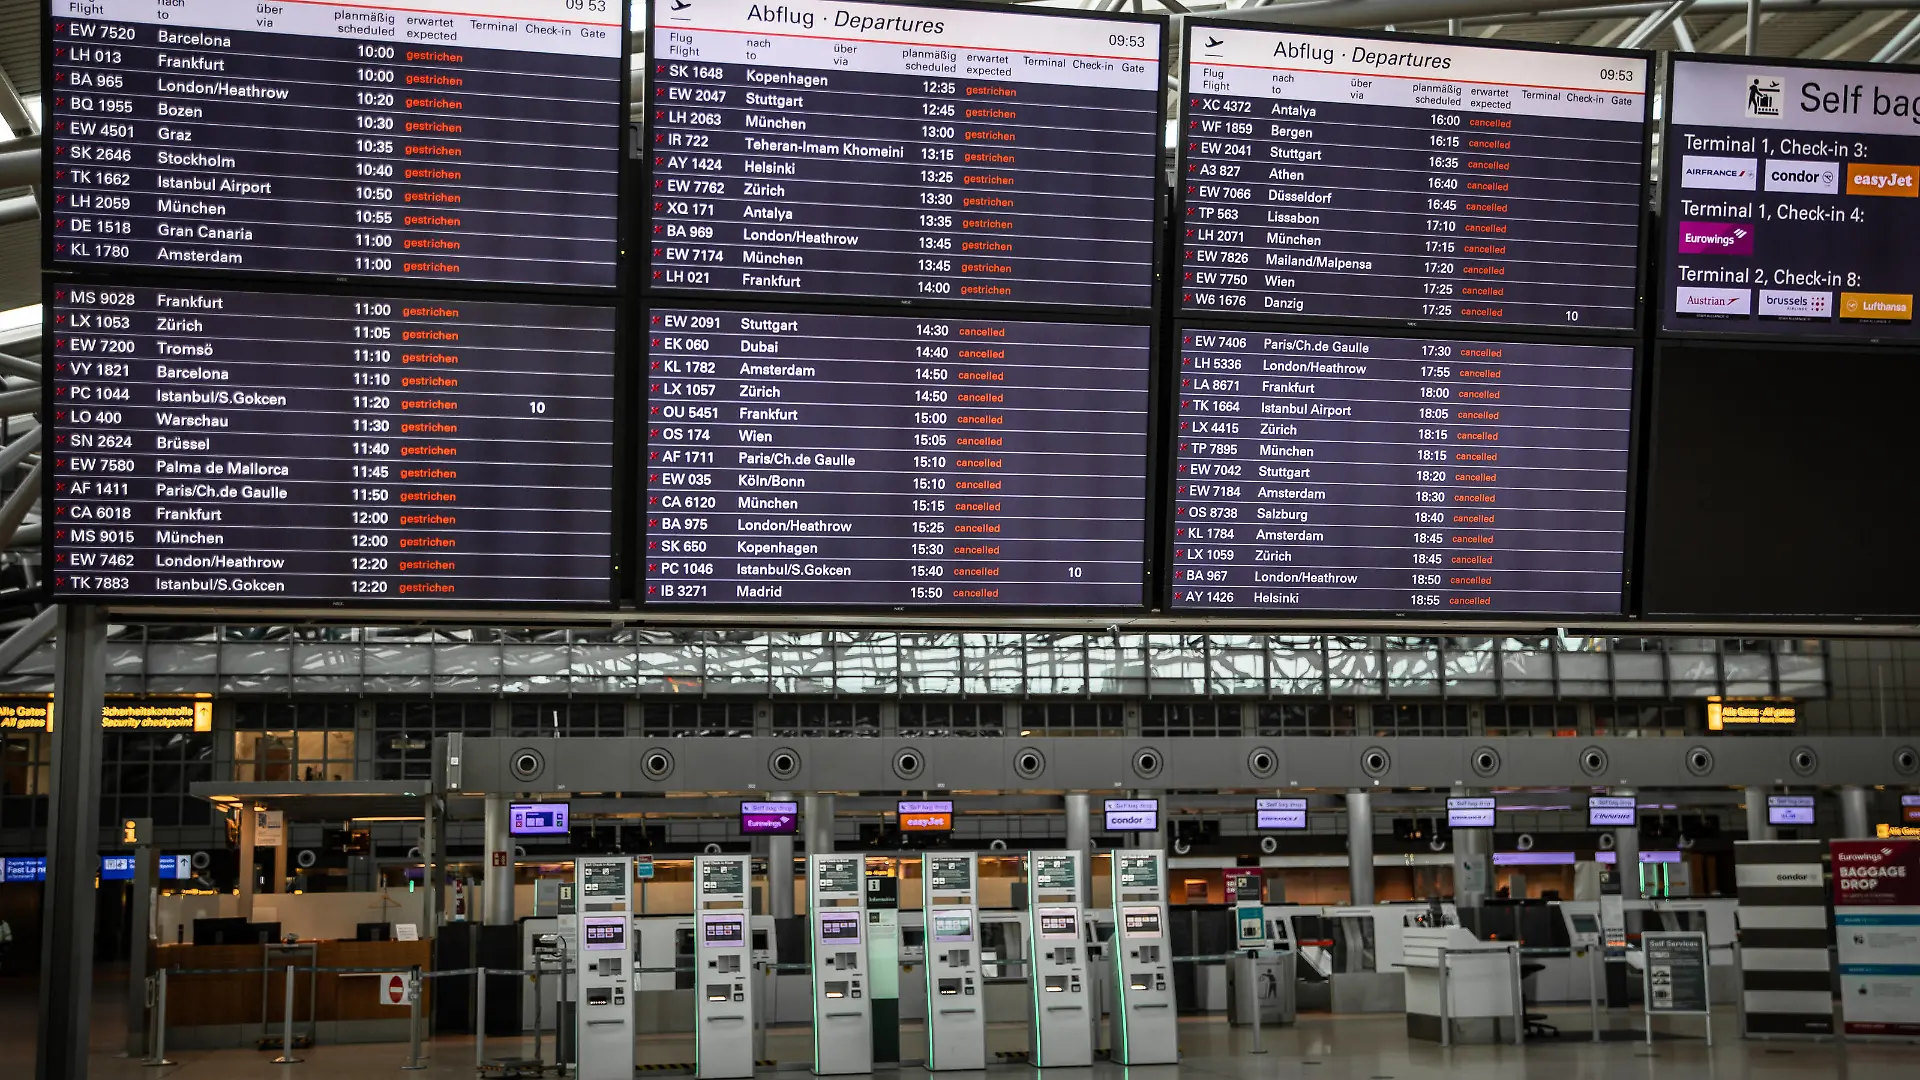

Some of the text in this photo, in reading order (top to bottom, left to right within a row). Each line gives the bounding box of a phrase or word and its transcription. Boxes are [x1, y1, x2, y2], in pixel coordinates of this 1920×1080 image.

[69, 2, 105, 16] Flight
[747, 4, 945, 34] Abflug Departures
[70, 23, 463, 63] EW 7520 Barcelona 10:00 gestrichen
[670, 32, 693, 45] Flug
[747, 39, 771, 48] nach
[1108, 34, 1145, 48] 09:53
[670, 45, 700, 58] Flight
[746, 51, 757, 60] to
[833, 43, 857, 54] über
[902, 48, 957, 63] planmäßig
[1273, 41, 1452, 69] Abflug Departures
[833, 56, 849, 66] via
[966, 54, 1009, 64] erwartet
[1023, 56, 1145, 73] Terminal Check-in Gate
[905, 61, 957, 73] scheduled
[966, 67, 1012, 77] expected
[669, 64, 1017, 97] SK 1648 Kopenhagen 12:35 gestrichen
[1600, 68, 1633, 82] 09:53
[71, 72, 463, 110] BA 965 London/Heathrow 10:20 gestrichen
[1800, 82, 1863, 114] Self
[668, 133, 1015, 163] IR 722 Teheran-Imam Khomeini 13:15 gestrichen
[1684, 133, 1868, 158] Terminal 1, Check-in 3:
[1199, 163, 1509, 192] A3 827 Athen 16:40 cancelled
[1771, 170, 1820, 183] condor
[1853, 173, 1913, 189] easyJet
[70, 170, 461, 203] TK 1662 Istanbul Airport 10:50 gestrichen
[1680, 199, 1864, 223] Terminal 1, Check-in 4:
[1685, 233, 1735, 247] Eurowings
[1197, 250, 1505, 275] EW 7826 Mailand/Malpensa 17:20 cancelled
[1678, 265, 1861, 287] Terminal 2, Check-in 8:
[1195, 293, 1578, 322] W6 1676 Danzig 17:25 cancelled 10
[1686, 295, 1726, 306] Austrian
[1766, 295, 1808, 306] brussels
[1863, 301, 1907, 312] Lufthansa
[664, 315, 1005, 337] EW 2091 Stuttgart 14:30 cancelled
[1194, 357, 1501, 379] LH 5336 London/Heathrow 17:55 cancelled
[71, 386, 546, 414] PC 1044 Istanbul/S.Gokcen 11:20 gestrichen 10
[71, 434, 457, 456] SN 2624 Brüssel 11:40 gestrichen
[1188, 506, 1495, 523] OS 8738 Salzburg 18:40 cancelled
[661, 562, 1082, 578] PC 1046 Istanbul/S.Gokcen 15:40 cancelled 10
[1185, 590, 1491, 606] AY 1426 Helsinki 18:55 cancelled
[16, 706, 46, 717] Gates
[1, 717, 46, 729] All gates
[102, 717, 193, 729] Security checkpoint
[907, 818, 945, 828] easyJet
[1111, 816, 1143, 825] condor
[1838, 852, 1882, 863] Eurowings
[1776, 873, 1808, 881] condor
[1839, 865, 1907, 879] BAGGAGE
[1841, 879, 1878, 891] DROP
[1649, 940, 1699, 948] Self Services
